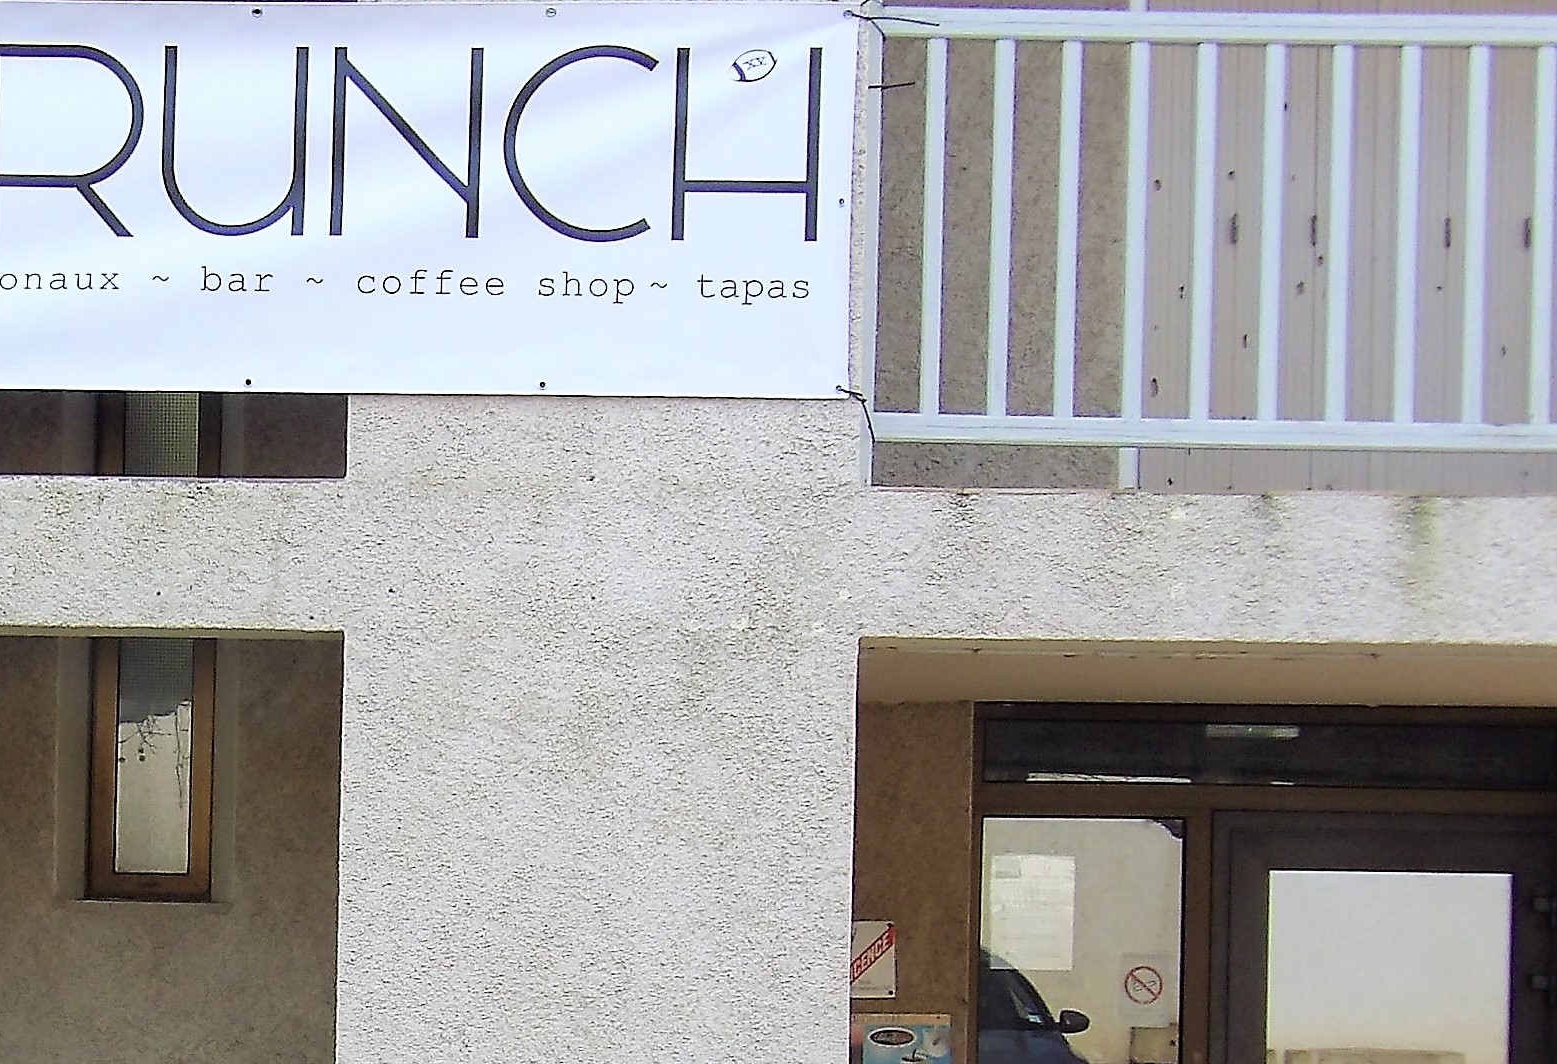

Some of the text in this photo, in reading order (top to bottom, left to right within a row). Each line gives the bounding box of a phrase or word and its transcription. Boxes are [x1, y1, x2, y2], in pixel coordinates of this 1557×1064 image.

[201, 265, 275, 293] bar
[355, 268, 506, 297] coffee
[696, 273, 810, 305] tapas
